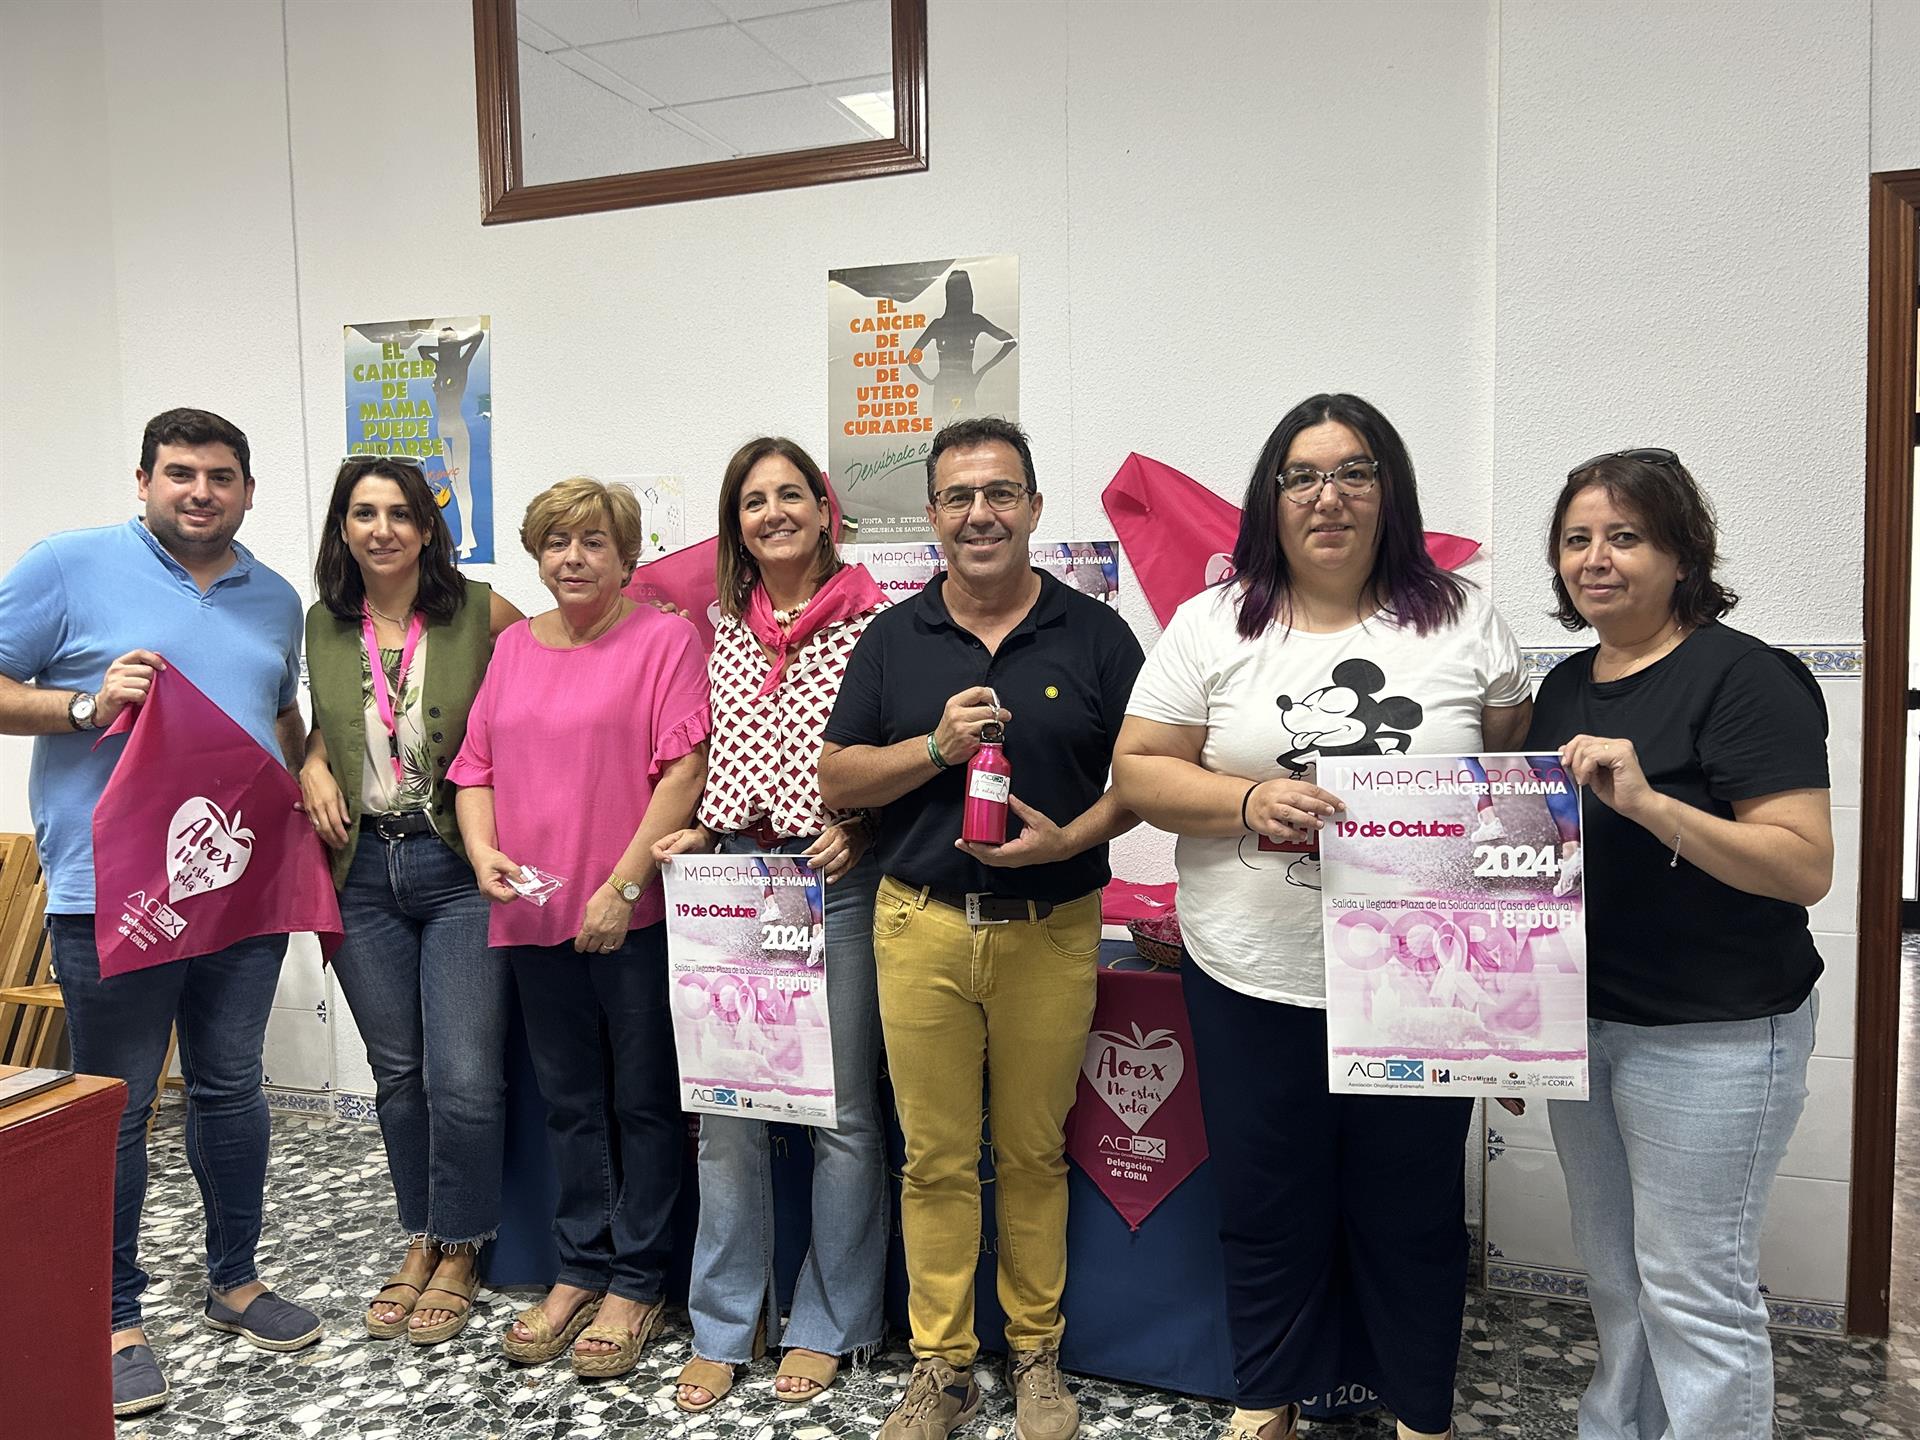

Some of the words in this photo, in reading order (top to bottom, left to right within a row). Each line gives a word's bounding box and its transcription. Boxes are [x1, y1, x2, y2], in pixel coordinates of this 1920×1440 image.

[877, 299, 897, 314] EL
[849, 314, 927, 333] CANCER
[875, 333, 900, 349] DE
[382, 342, 404, 361] EL
[853, 348, 923, 367] CUELLO
[353, 360, 436, 382] CANCER
[876, 367, 900, 383] DE
[381, 381, 408, 400] DE
[857, 383, 919, 401] UTERO
[360, 400, 433, 421] MAMA
[857, 401, 918, 418] PUEDE
[363, 420, 429, 440] PUEDE
[843, 417, 933, 436] CURARSE
[352, 438, 444, 457] CURARSE
[861, 517, 882, 525] JUNTA
[873, 551, 932, 564] MARCHA
[1074, 557, 1084, 565] DE
[1086, 556, 1113, 564] MAMA
[1353, 770, 1475, 791] MARCHA
[1486, 768, 1565, 787] ROSA
[1492, 782, 1512, 795] DE
[1515, 781, 1568, 795] MAMA
[1335, 821, 1358, 838] 19
[1360, 821, 1386, 838] de
[1388, 820, 1466, 838] Octubre
[1473, 845, 1560, 878] 2024
[684, 866, 761, 881] MARCHA
[772, 877, 785, 887] DE
[786, 877, 817, 887] MAMA
[676, 904, 690, 917] 19
[691, 904, 708, 917] de
[709, 904, 757, 918] Octubre
[1332, 899, 1358, 909] Salida
[1360, 901, 1364, 911] y
[1366, 900, 1398, 911] llegada:
[1400, 900, 1424, 909] Plaza
[1426, 900, 1436, 909] de
[1438, 900, 1447, 910] la
[1448, 900, 1496, 910] Solidaridad
[1498, 900, 1522, 911] (Casa
[1524, 901, 1536, 911] de
[1537, 901, 1573, 911] Cultura)
[121, 912, 159, 945] Delegación
[118, 925, 131, 937] de
[129, 932, 149, 952] CORIA
[761, 925, 812, 951] 2024
[1096, 1046, 1168, 1081] Aoex
[1348, 1062, 1423, 1080] AOEX
[691, 1088, 737, 1105] AOEX
[1106, 1157, 1153, 1173] Delegación
[1111, 1168, 1122, 1178] de
[1123, 1170, 1148, 1182] CORIA
